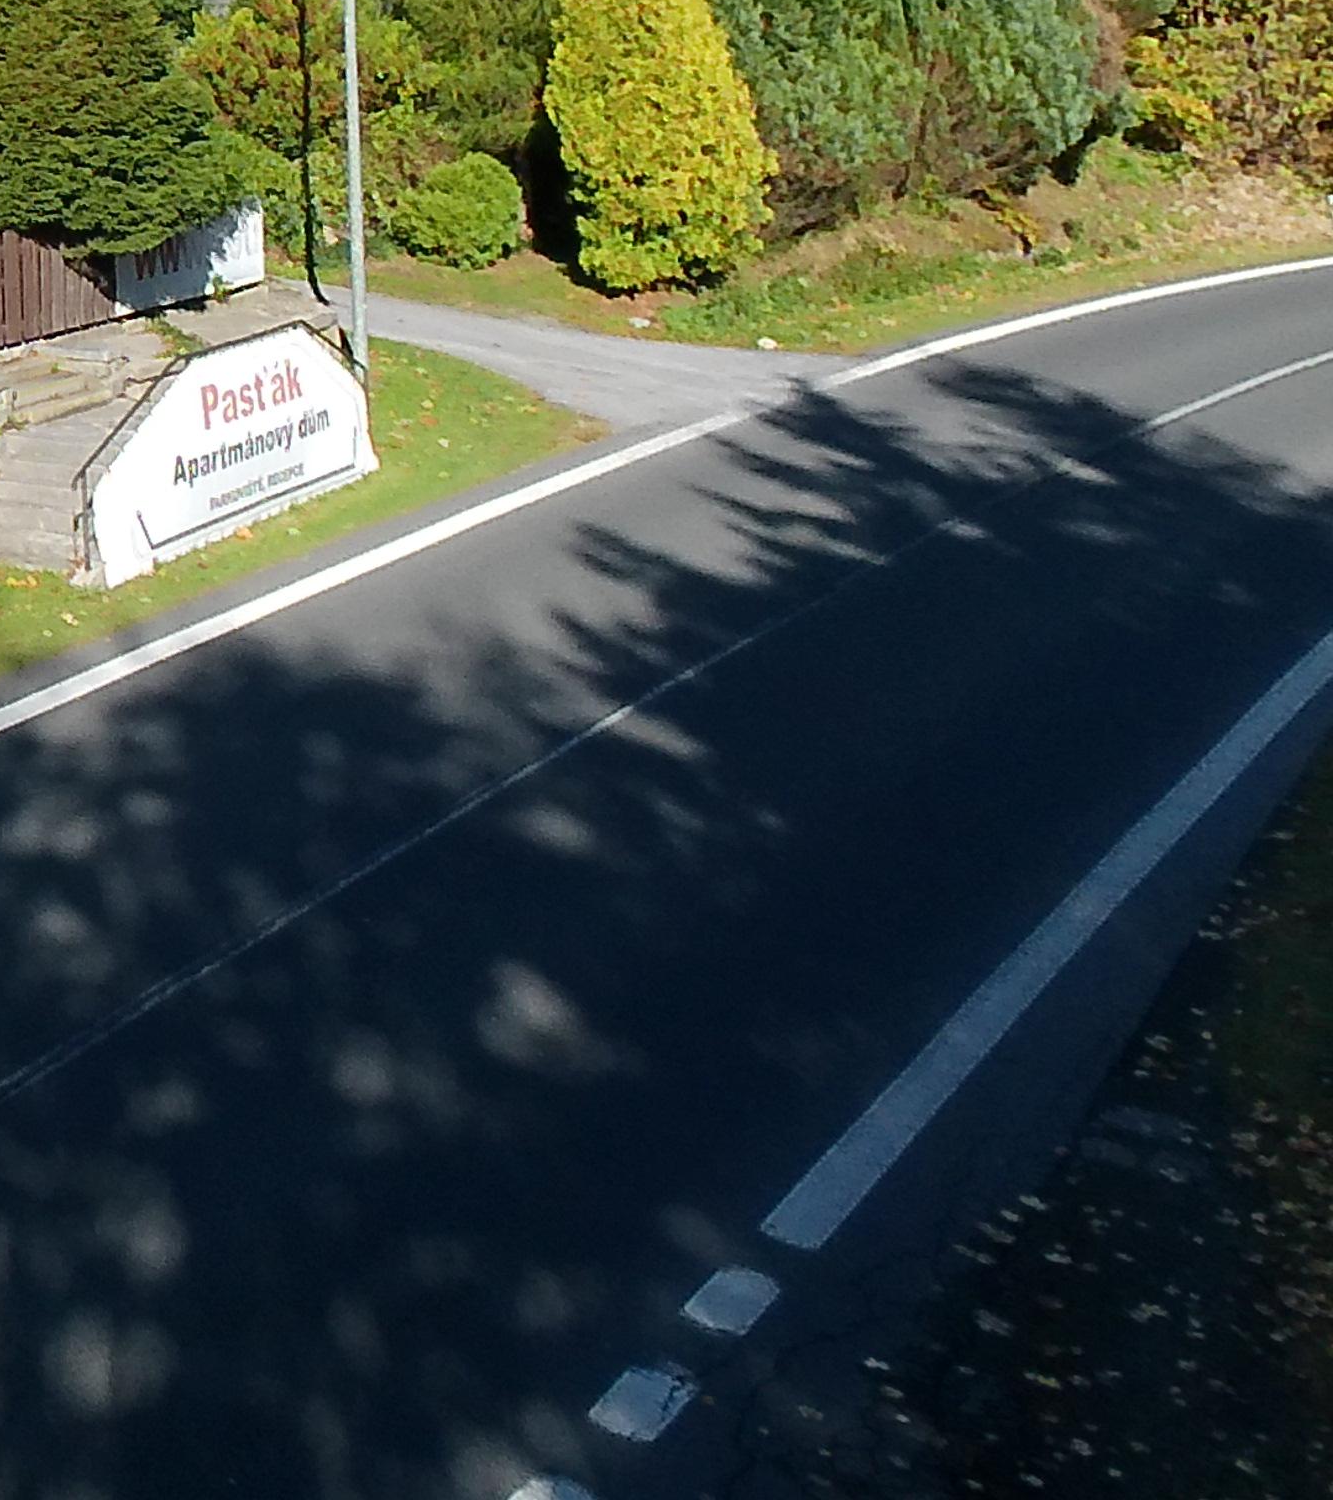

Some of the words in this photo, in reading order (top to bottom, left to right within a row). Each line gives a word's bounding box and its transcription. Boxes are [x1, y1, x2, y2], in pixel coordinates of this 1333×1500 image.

[200, 359, 303, 430] Pasťák
[173, 417, 294, 488] Apartmánový
[298, 407, 331, 439] dům
